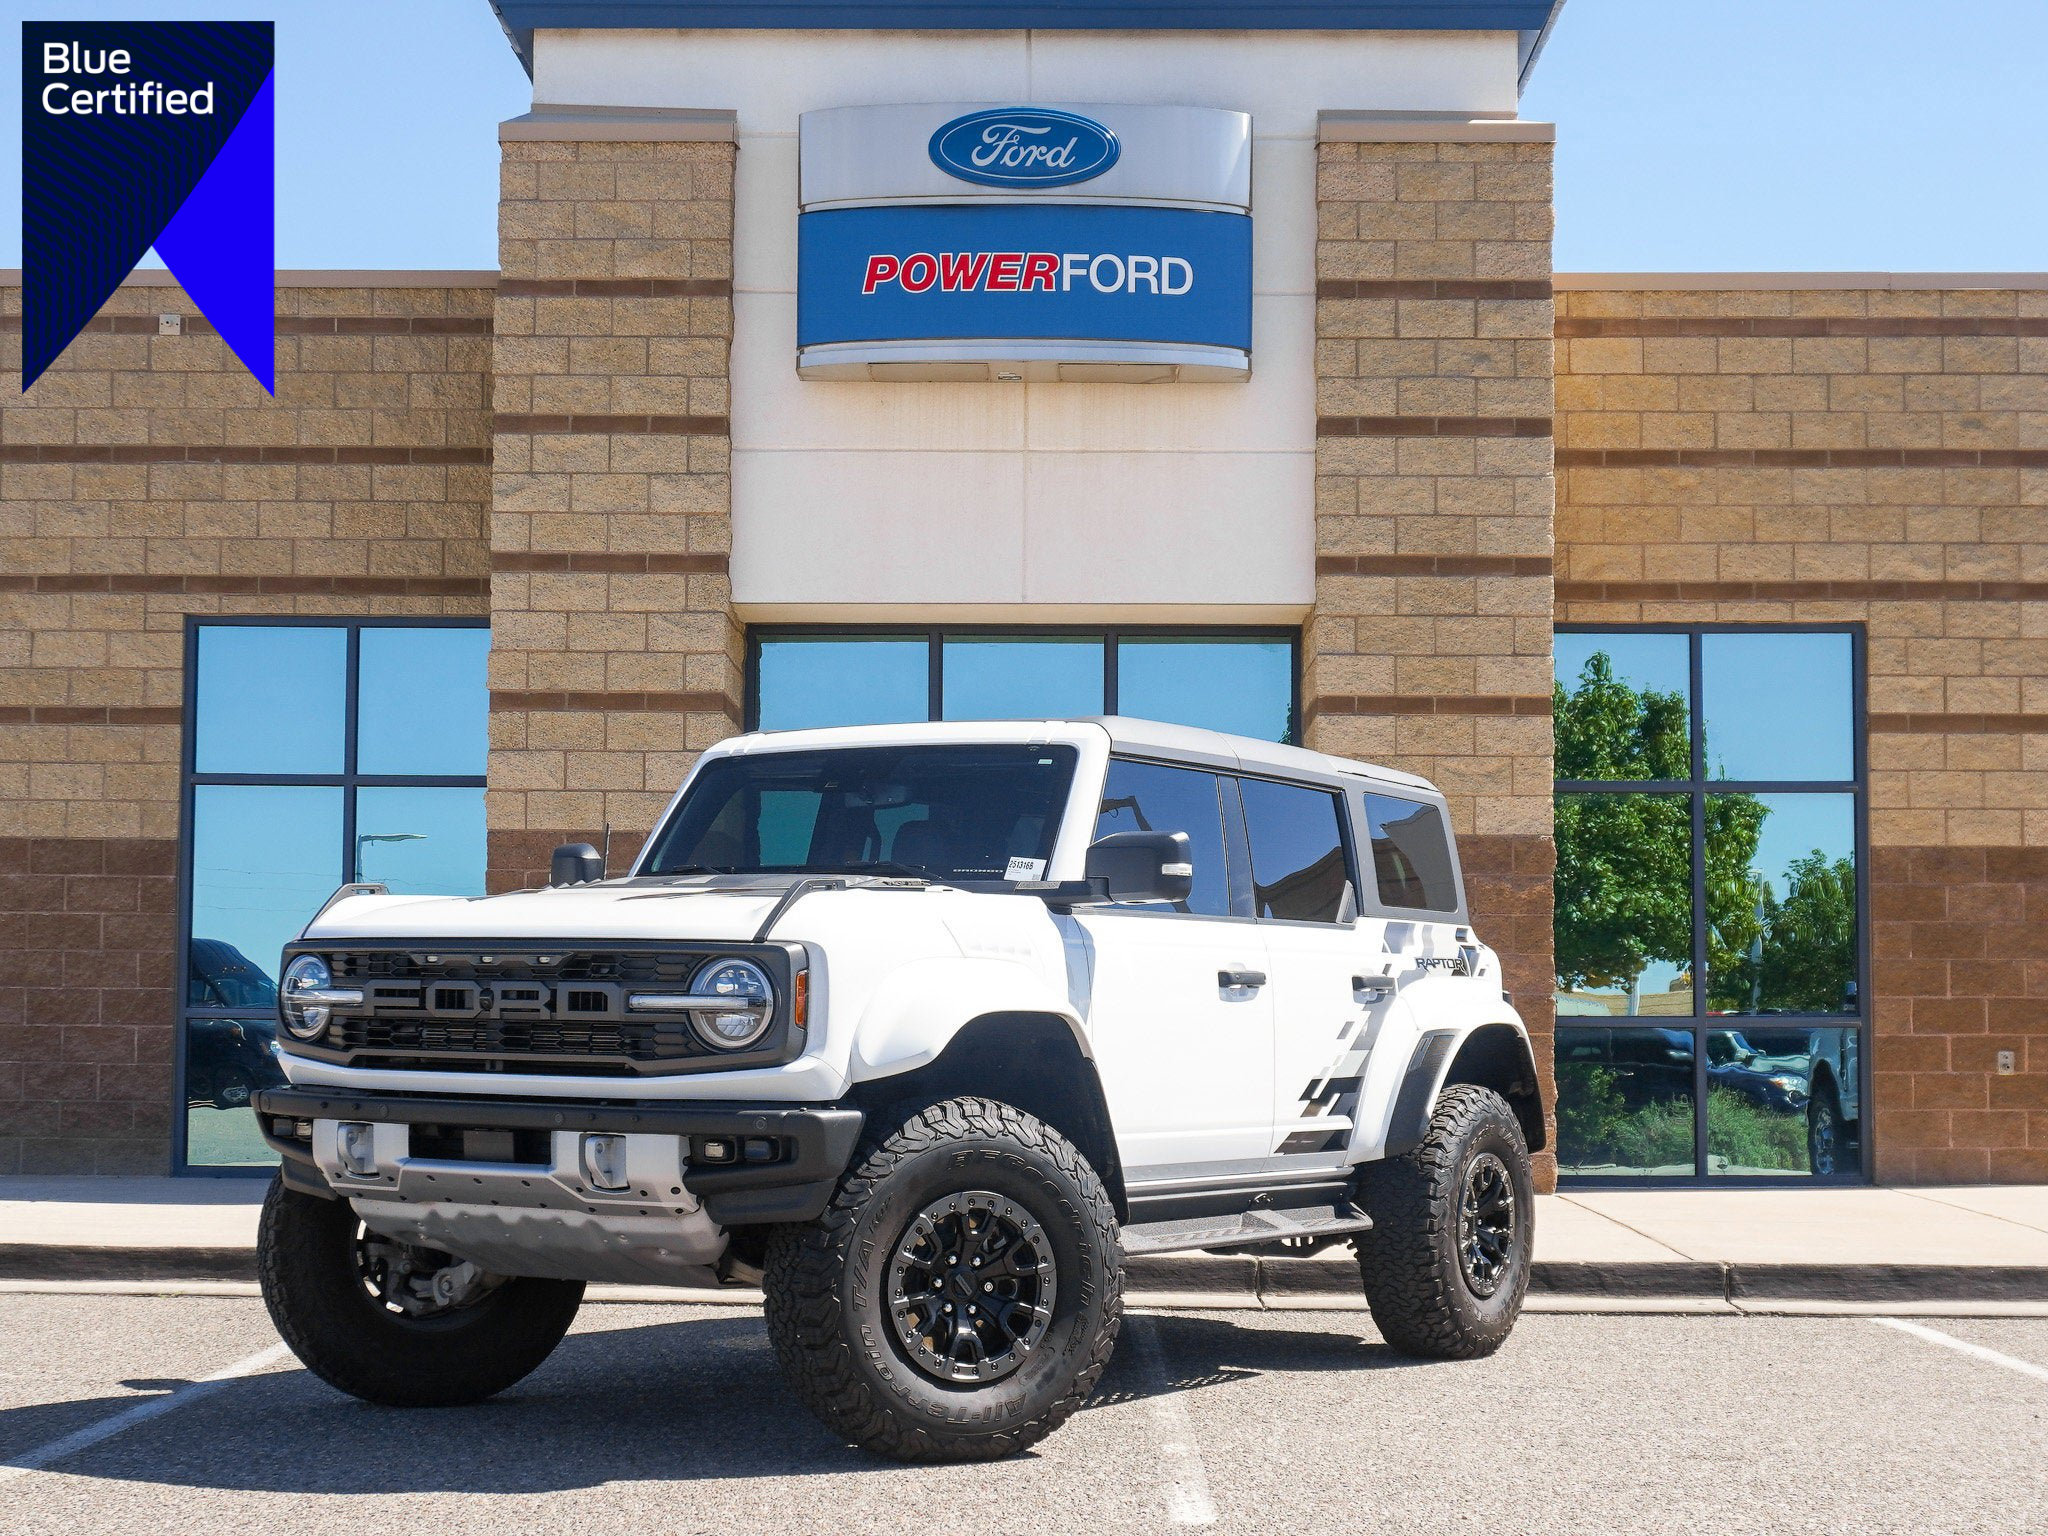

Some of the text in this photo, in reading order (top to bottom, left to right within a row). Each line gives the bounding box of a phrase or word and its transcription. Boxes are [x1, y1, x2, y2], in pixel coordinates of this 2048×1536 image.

[970, 123, 1079, 169] Ford
[1414, 957, 1468, 976] RAPTOR
[364, 979, 624, 1021] FORD
